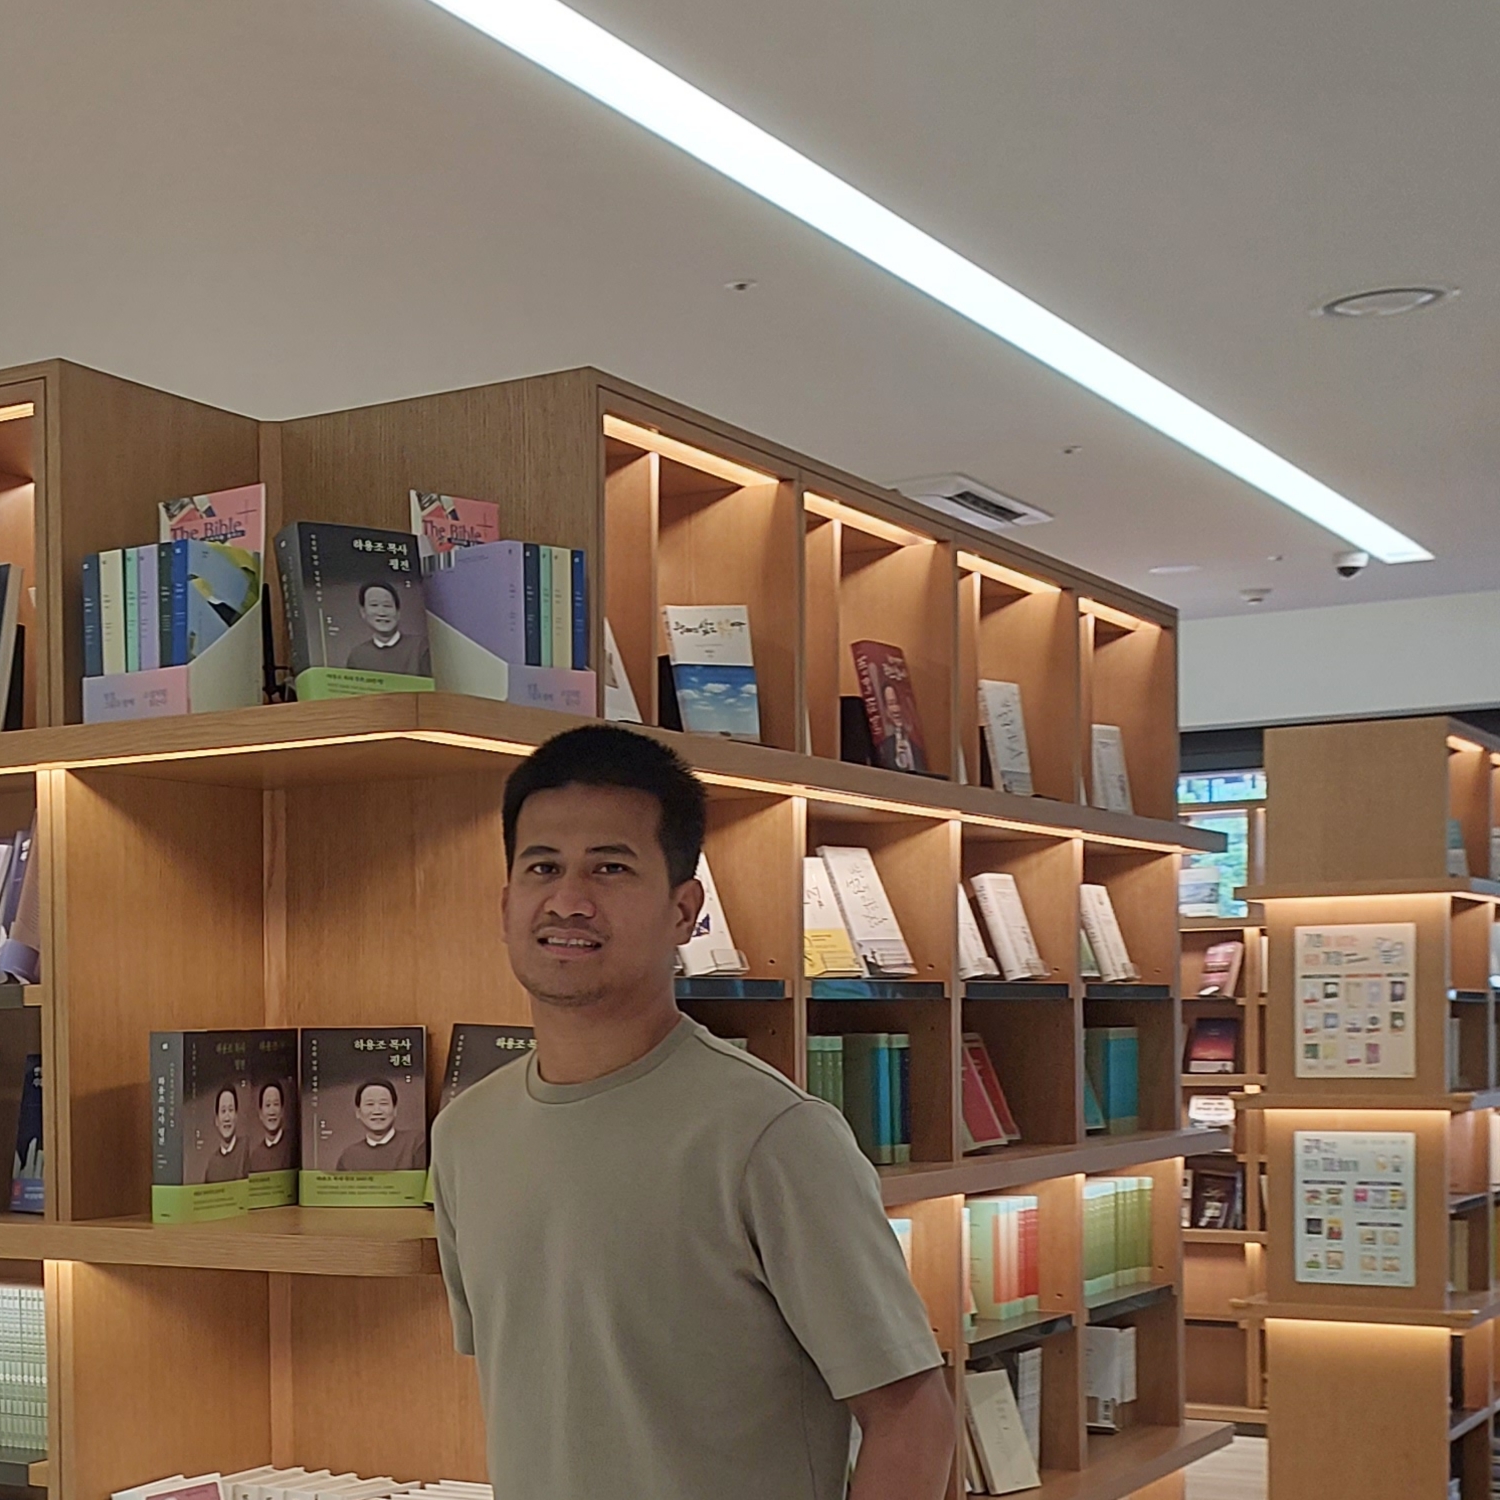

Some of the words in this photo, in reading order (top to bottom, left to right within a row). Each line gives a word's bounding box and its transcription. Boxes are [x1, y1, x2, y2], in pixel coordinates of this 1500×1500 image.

[170, 526, 198, 541] The
[204, 517, 242, 538] Bible
[422, 518, 446, 537] The
[450, 523, 482, 541] Bible
[353, 1038, 387, 1051] 하용조
[389, 1038, 412, 1051] 목사
[495, 1036, 526, 1050] 하용조
[389, 1053, 412, 1067] 평전
